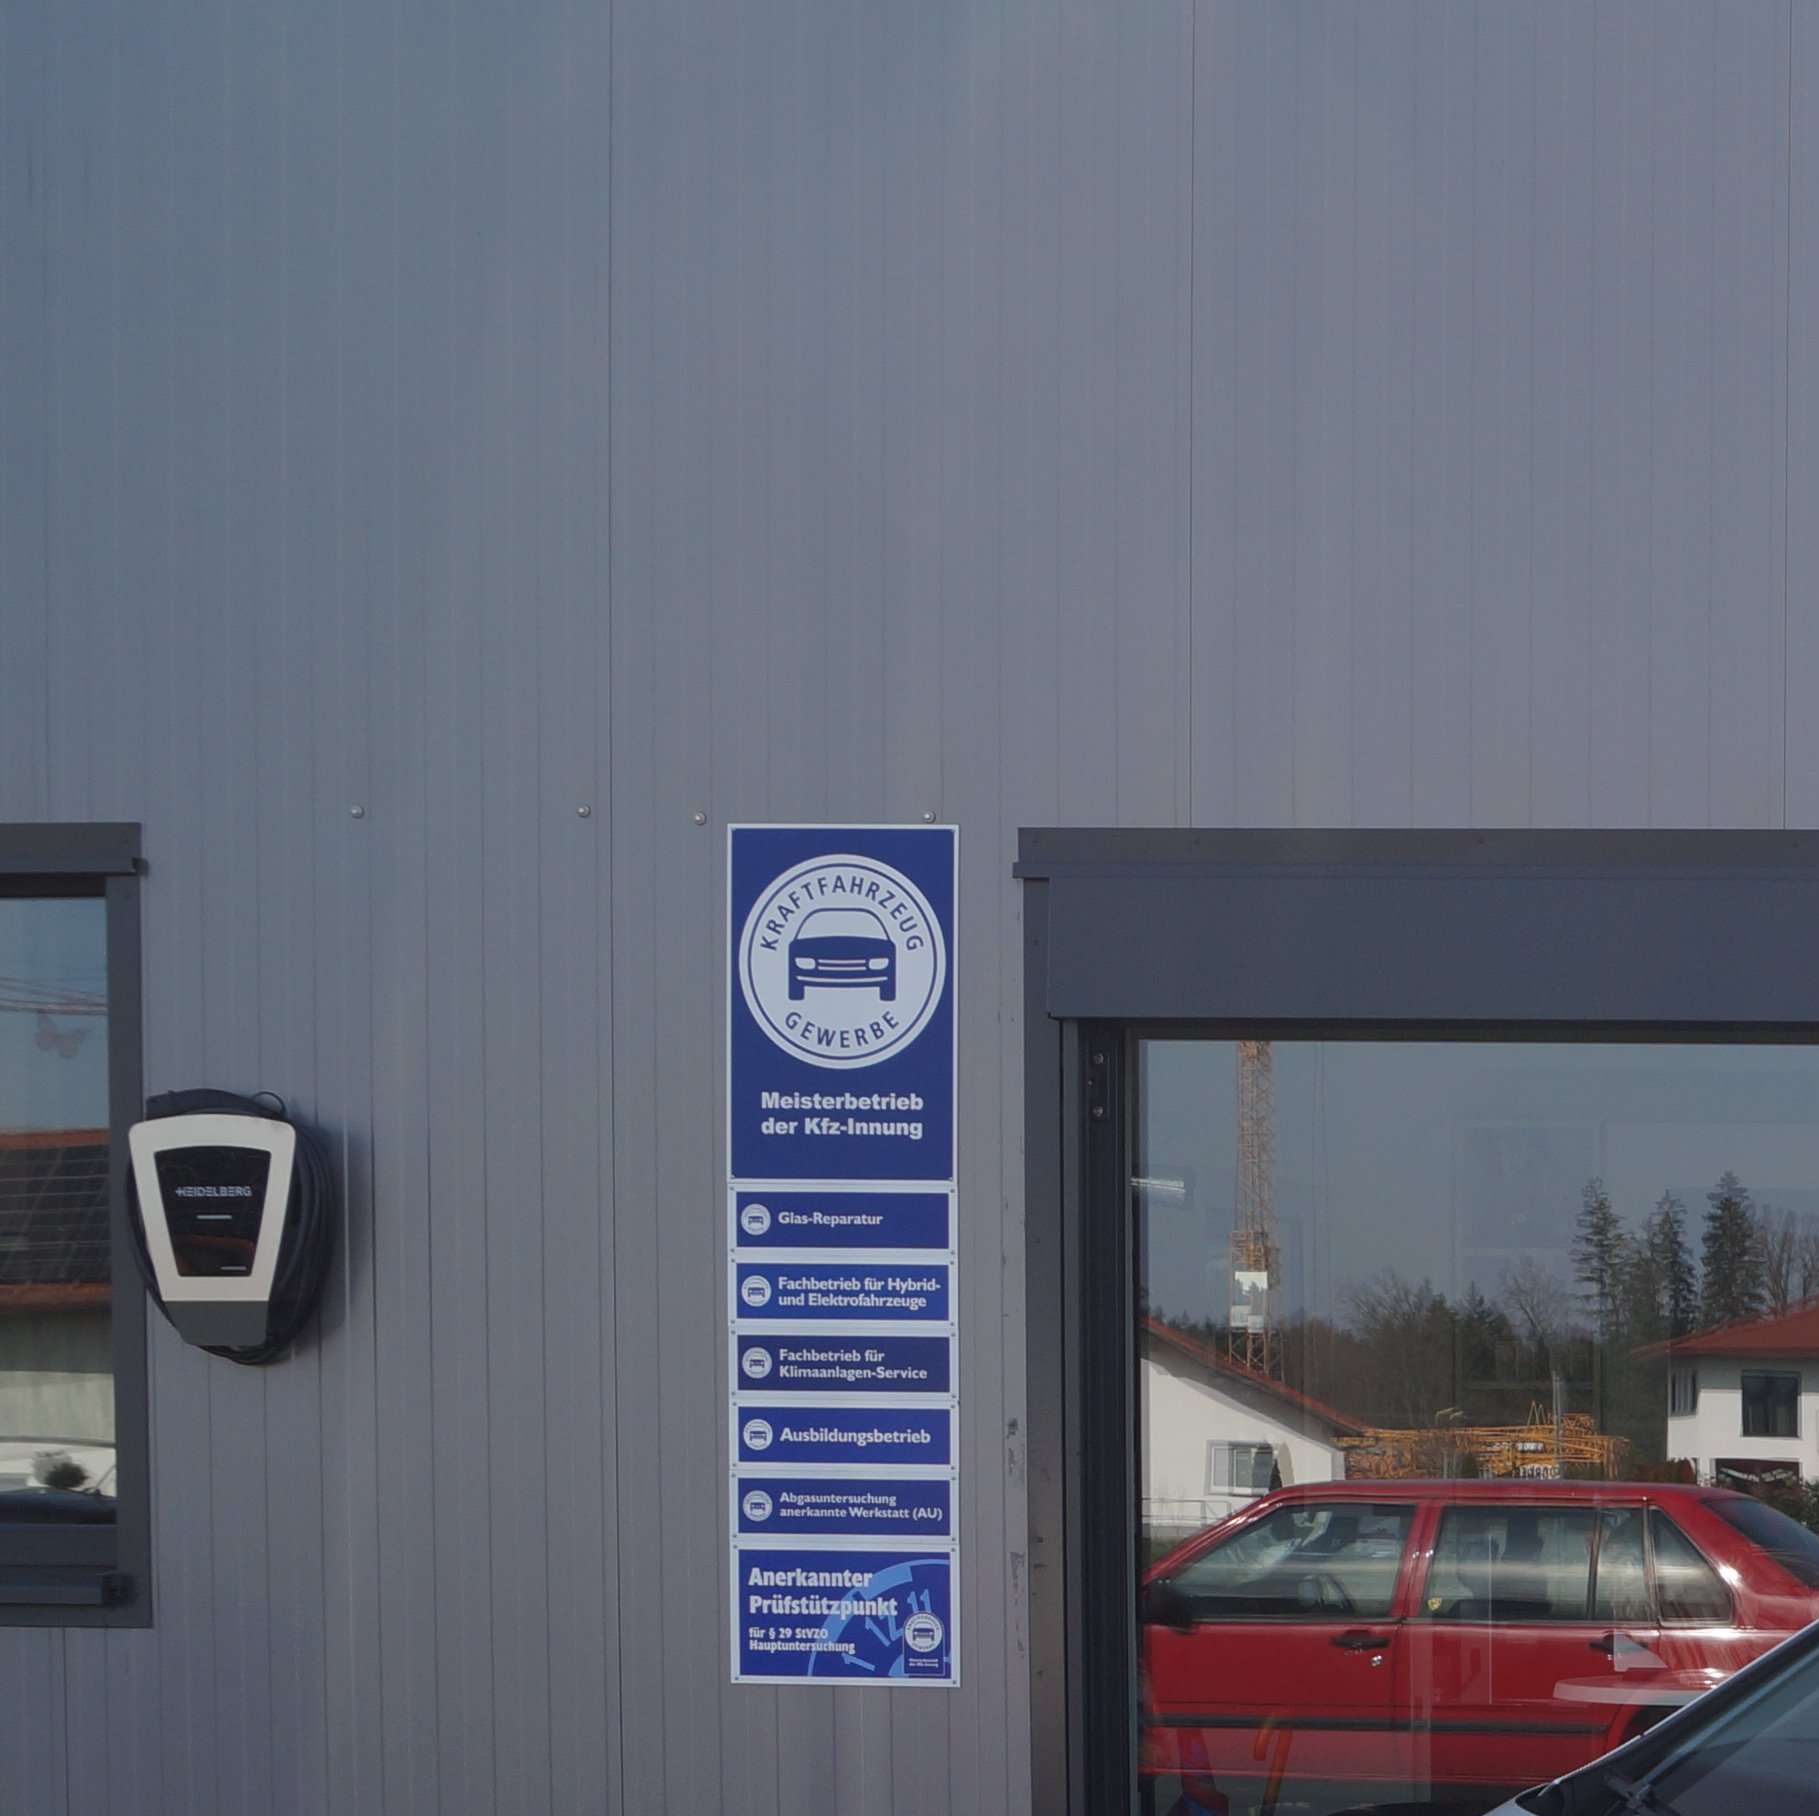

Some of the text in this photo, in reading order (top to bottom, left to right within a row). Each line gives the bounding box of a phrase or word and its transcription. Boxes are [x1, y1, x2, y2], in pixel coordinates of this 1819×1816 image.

[760, 875, 924, 952] KRAFTFAHRZEUG
[784, 1010, 900, 1049] GEWERBE
[761, 1091, 924, 1110] Meisterbetrieb
[761, 1117, 923, 1139] der Kfz-Innung
[178, 1186, 252, 1197] HEIDELBERG
[778, 1211, 884, 1228] Glas-Reparatur
[778, 1276, 941, 1294] Fachbetrieb für Hybrid-
[778, 1293, 927, 1311] und Elektrofahrzeuge
[779, 1348, 885, 1362] Fachbetrieb für
[779, 1365, 928, 1381] Klimaanlagen-Service
[780, 1427, 931, 1446] Ausbildungsbetrieb
[780, 1492, 897, 1506] Abgasuntersuchung
[780, 1507, 943, 1521] anerkannte Werkstatt (AU)
[748, 1567, 873, 1588] Anerkannter
[749, 1594, 898, 1620] Prüfstützpunkt
[749, 1627, 829, 1640] für § 29 StVZO
[749, 1640, 856, 1655] Hauptuntersuchung
